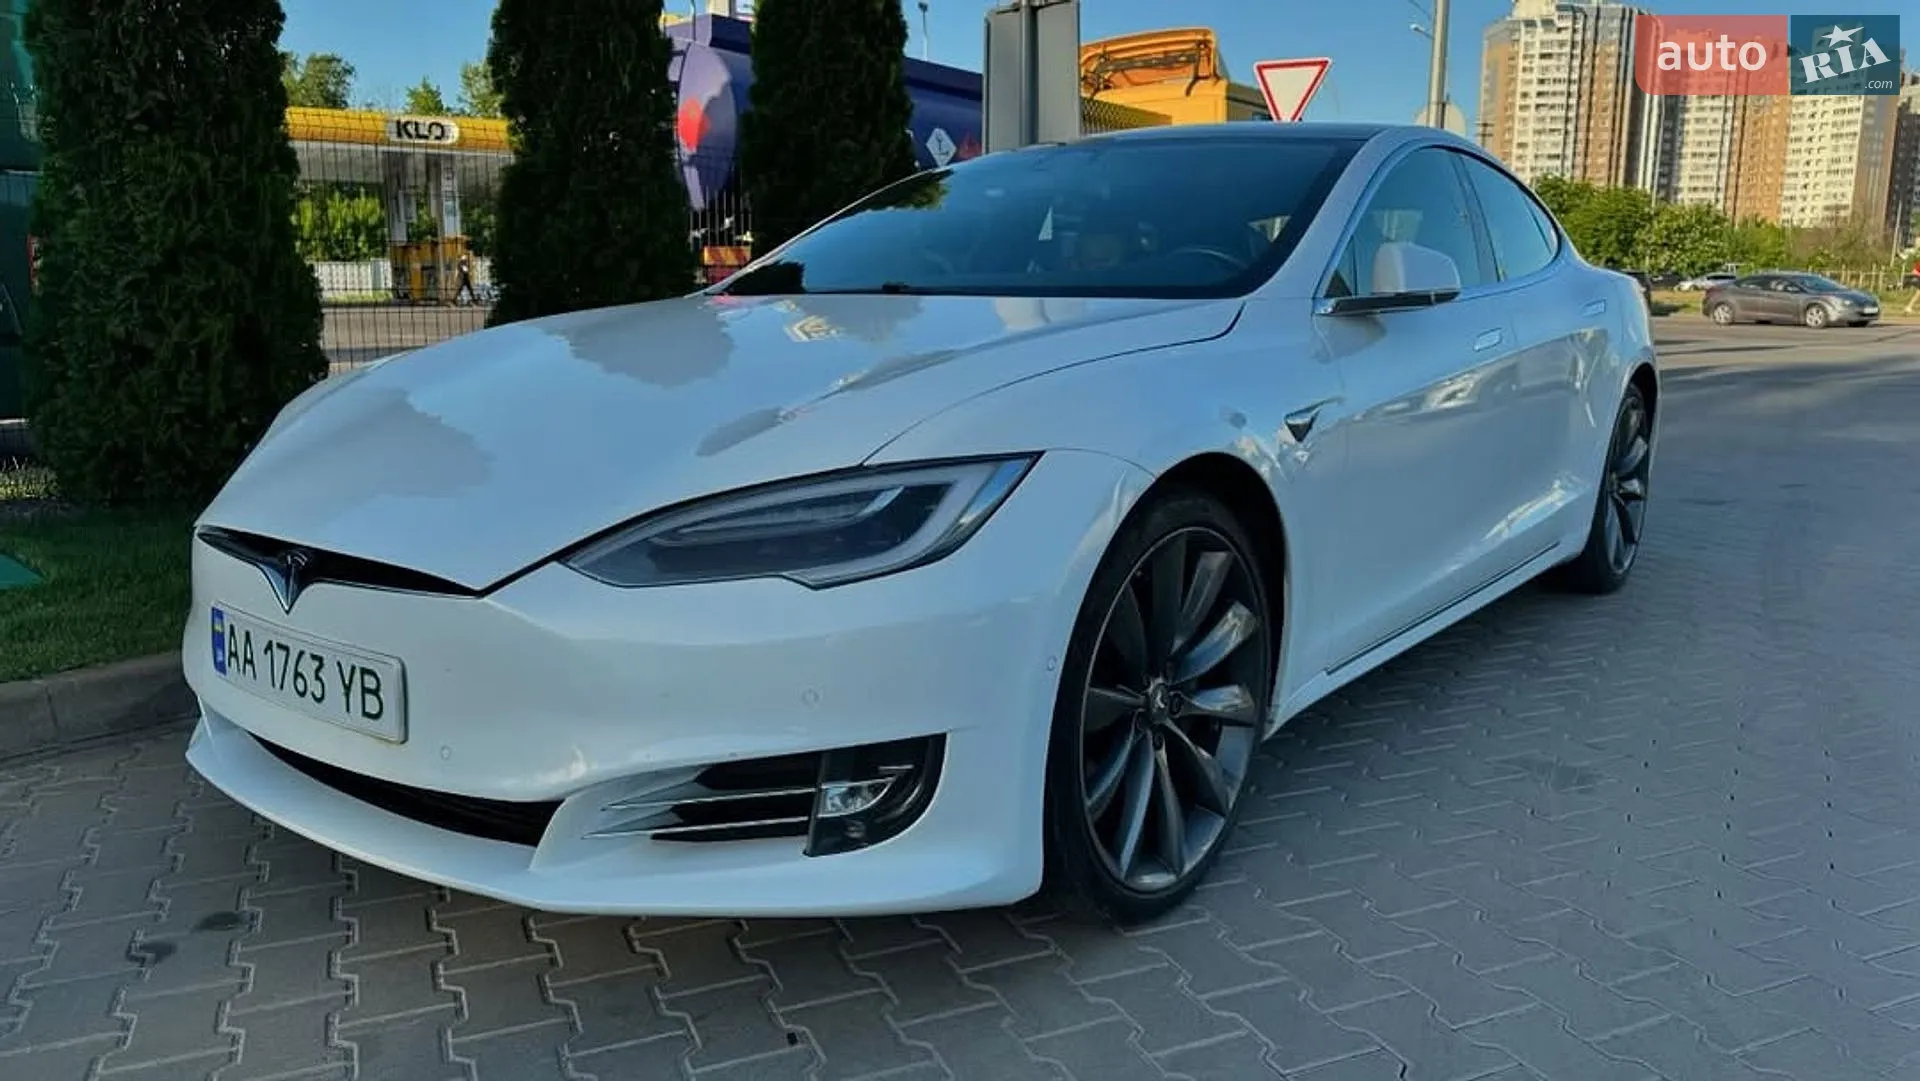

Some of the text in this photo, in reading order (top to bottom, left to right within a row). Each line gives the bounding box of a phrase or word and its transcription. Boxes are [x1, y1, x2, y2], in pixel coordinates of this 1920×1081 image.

[396, 119, 445, 140] KLO
[227, 624, 384, 720] AA 1763 YB
